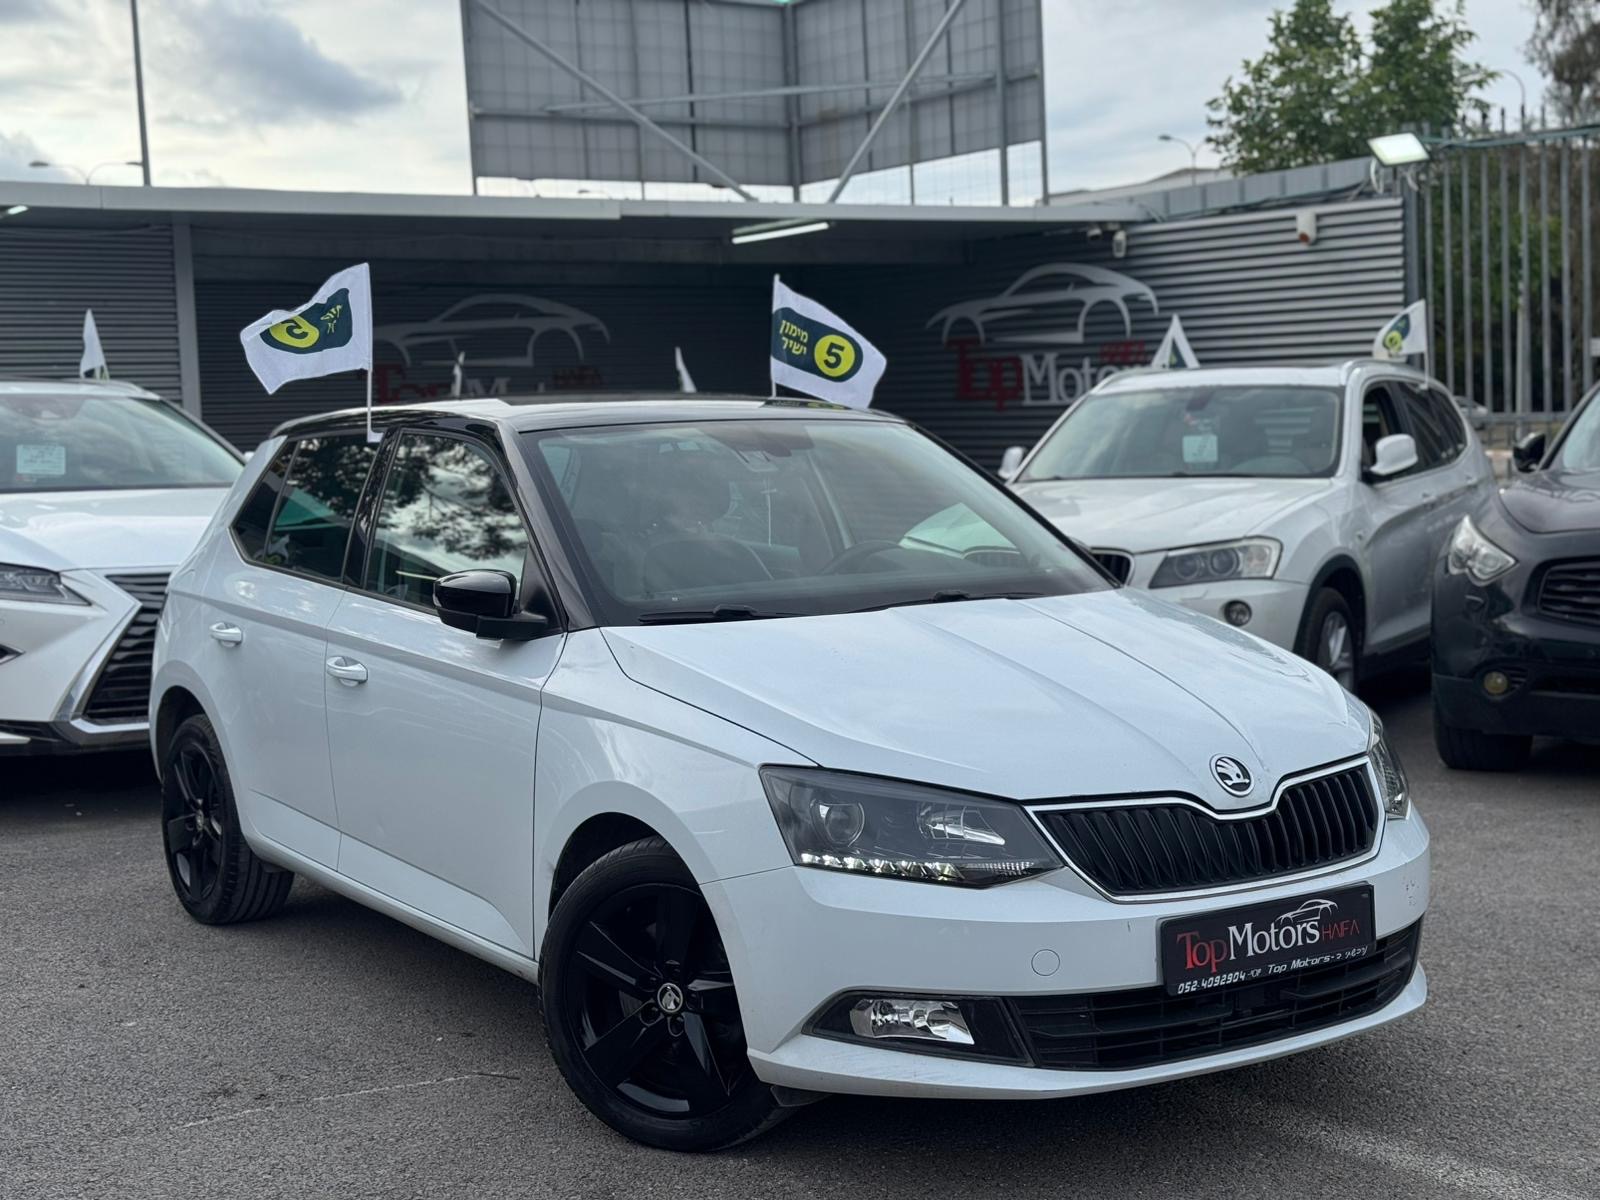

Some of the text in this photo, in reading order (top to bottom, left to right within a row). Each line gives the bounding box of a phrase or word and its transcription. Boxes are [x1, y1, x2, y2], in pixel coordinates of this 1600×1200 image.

[779, 319, 809, 343] מימון
[823, 341, 846, 370] 5
[1321, 919, 1361, 942] HAIFA
[1267, 963, 1287, 975] Top
